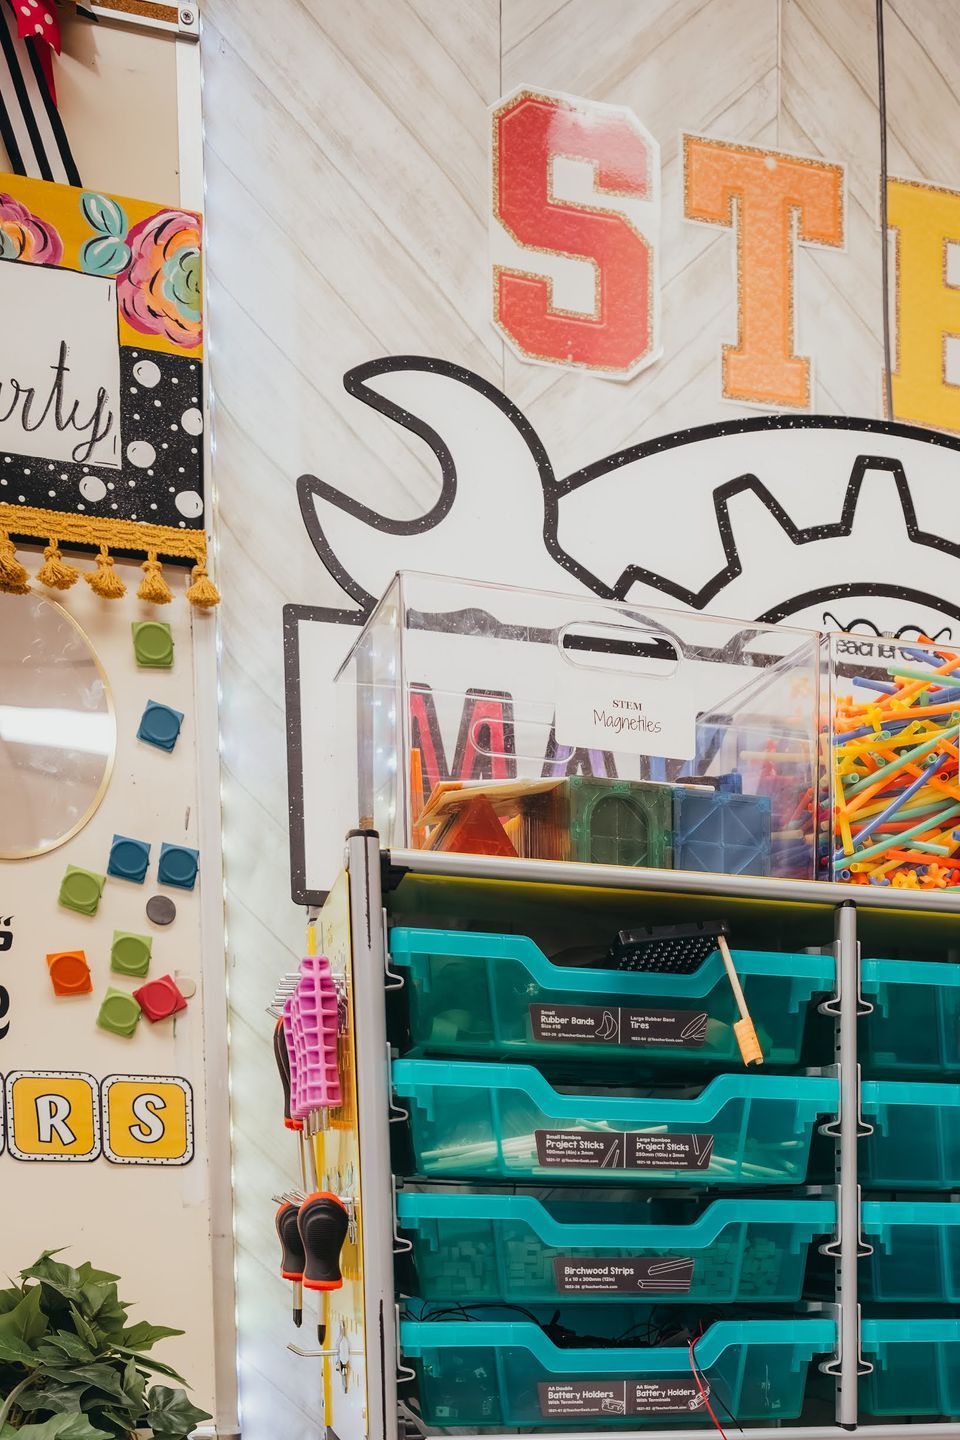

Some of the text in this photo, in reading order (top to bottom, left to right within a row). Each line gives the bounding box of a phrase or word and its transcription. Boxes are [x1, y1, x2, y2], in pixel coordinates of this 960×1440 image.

[612, 700, 642, 711] STEM
[593, 709, 662, 733] Magnetiles
[540, 1016, 595, 1026] Rubber Bands
[630, 1021, 649, 1029] Tires
[546, 1140, 604, 1150] Project Sticks
[636, 1142, 689, 1151] Project Sticks
[564, 1267, 634, 1275] Birchwood Strips
[548, 1391, 580, 1399] Battery
[636, 1388, 696, 1398] Battery Holders
